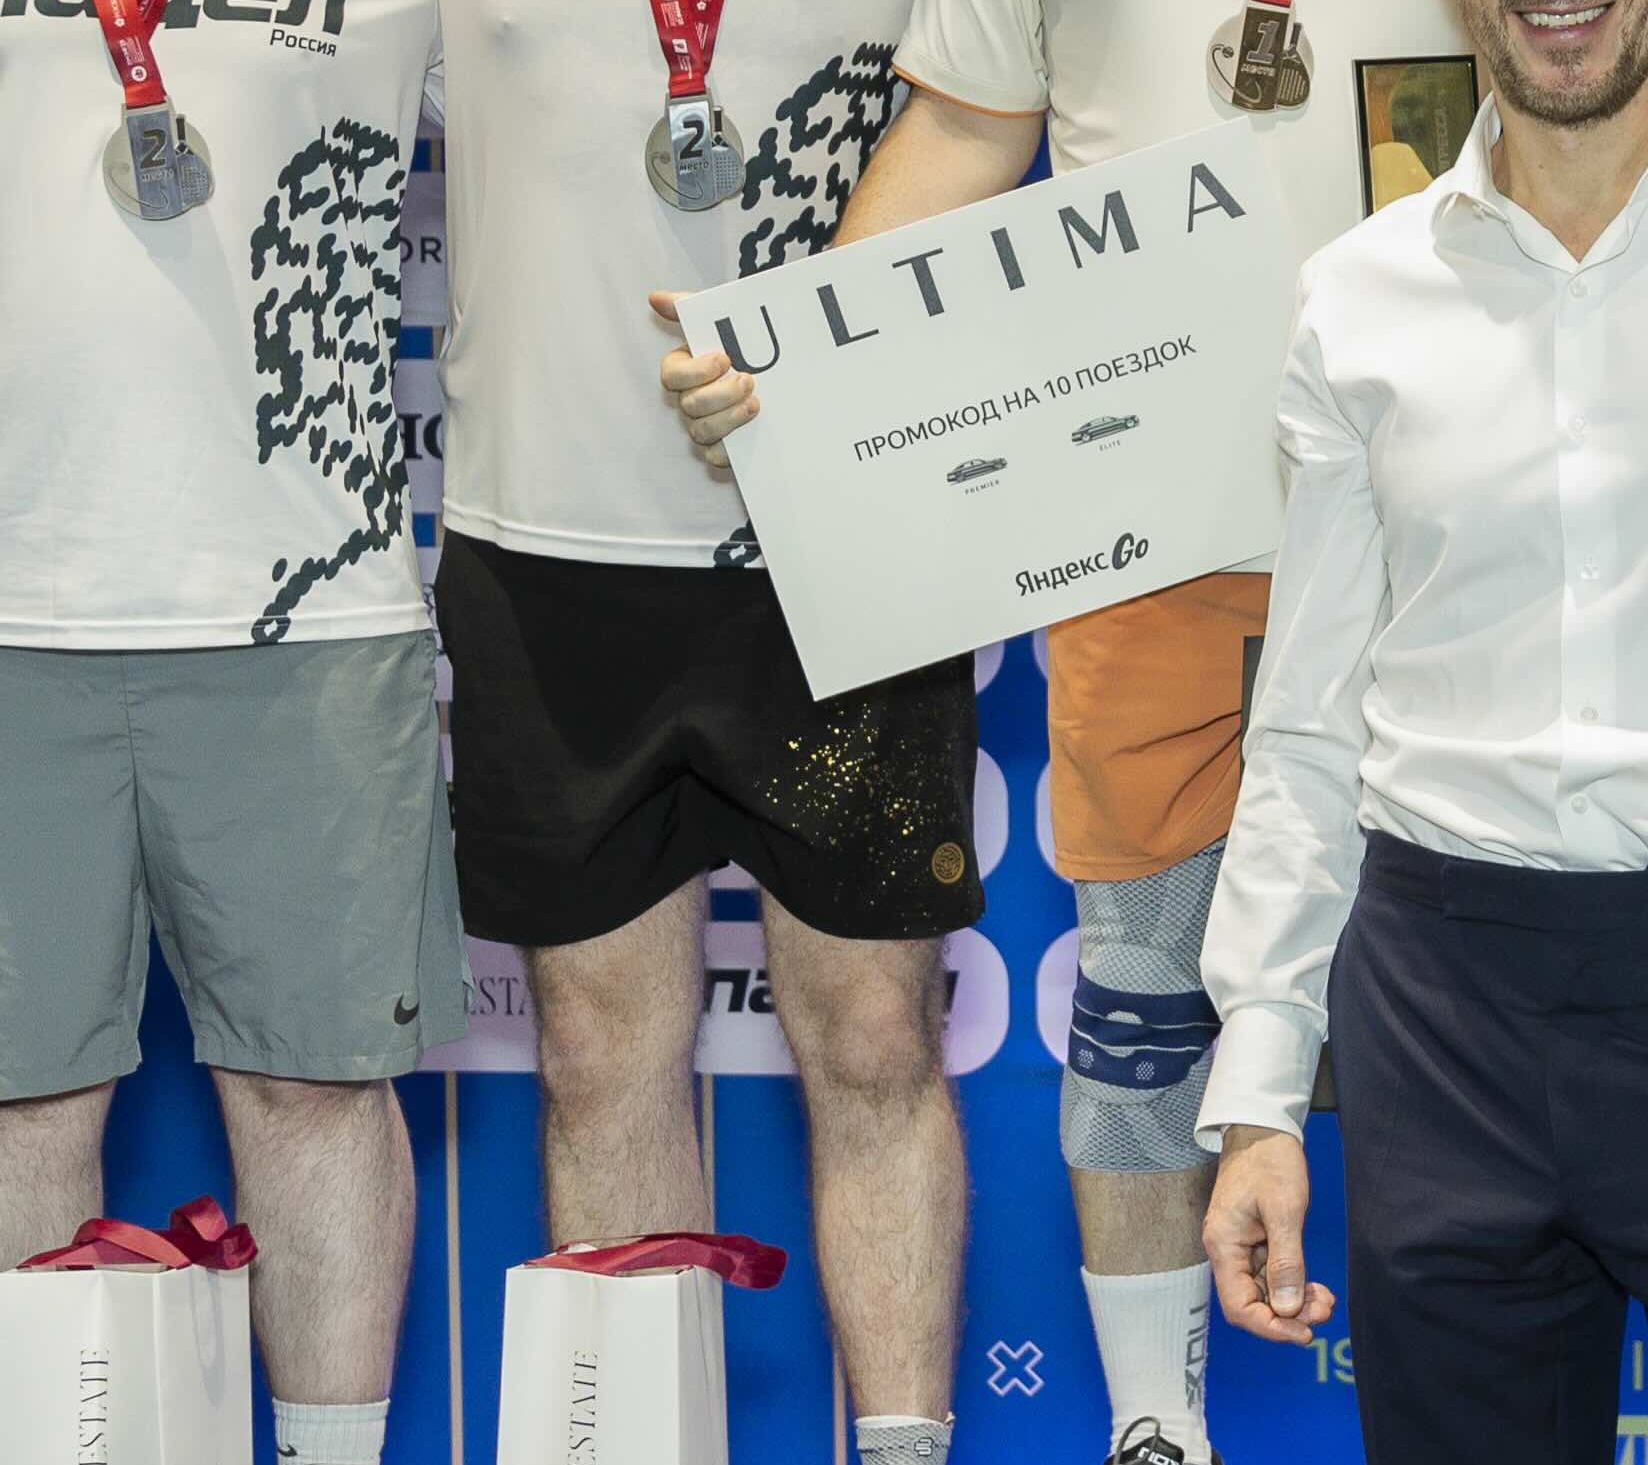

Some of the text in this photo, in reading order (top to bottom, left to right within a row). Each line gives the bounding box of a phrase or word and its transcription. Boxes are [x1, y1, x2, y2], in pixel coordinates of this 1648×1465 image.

[269, 28, 338, 58] Россия
[1247, 20, 1280, 64] 1
[139, 128, 167, 170] 2
[679, 119, 705, 160] 2
[715, 162, 1247, 377] ULTIMA
[852, 333, 1198, 463] ПРОМОКОД НА 10 ПОЕЗДОК
[1014, 532, 1150, 598] Яндекс Go
